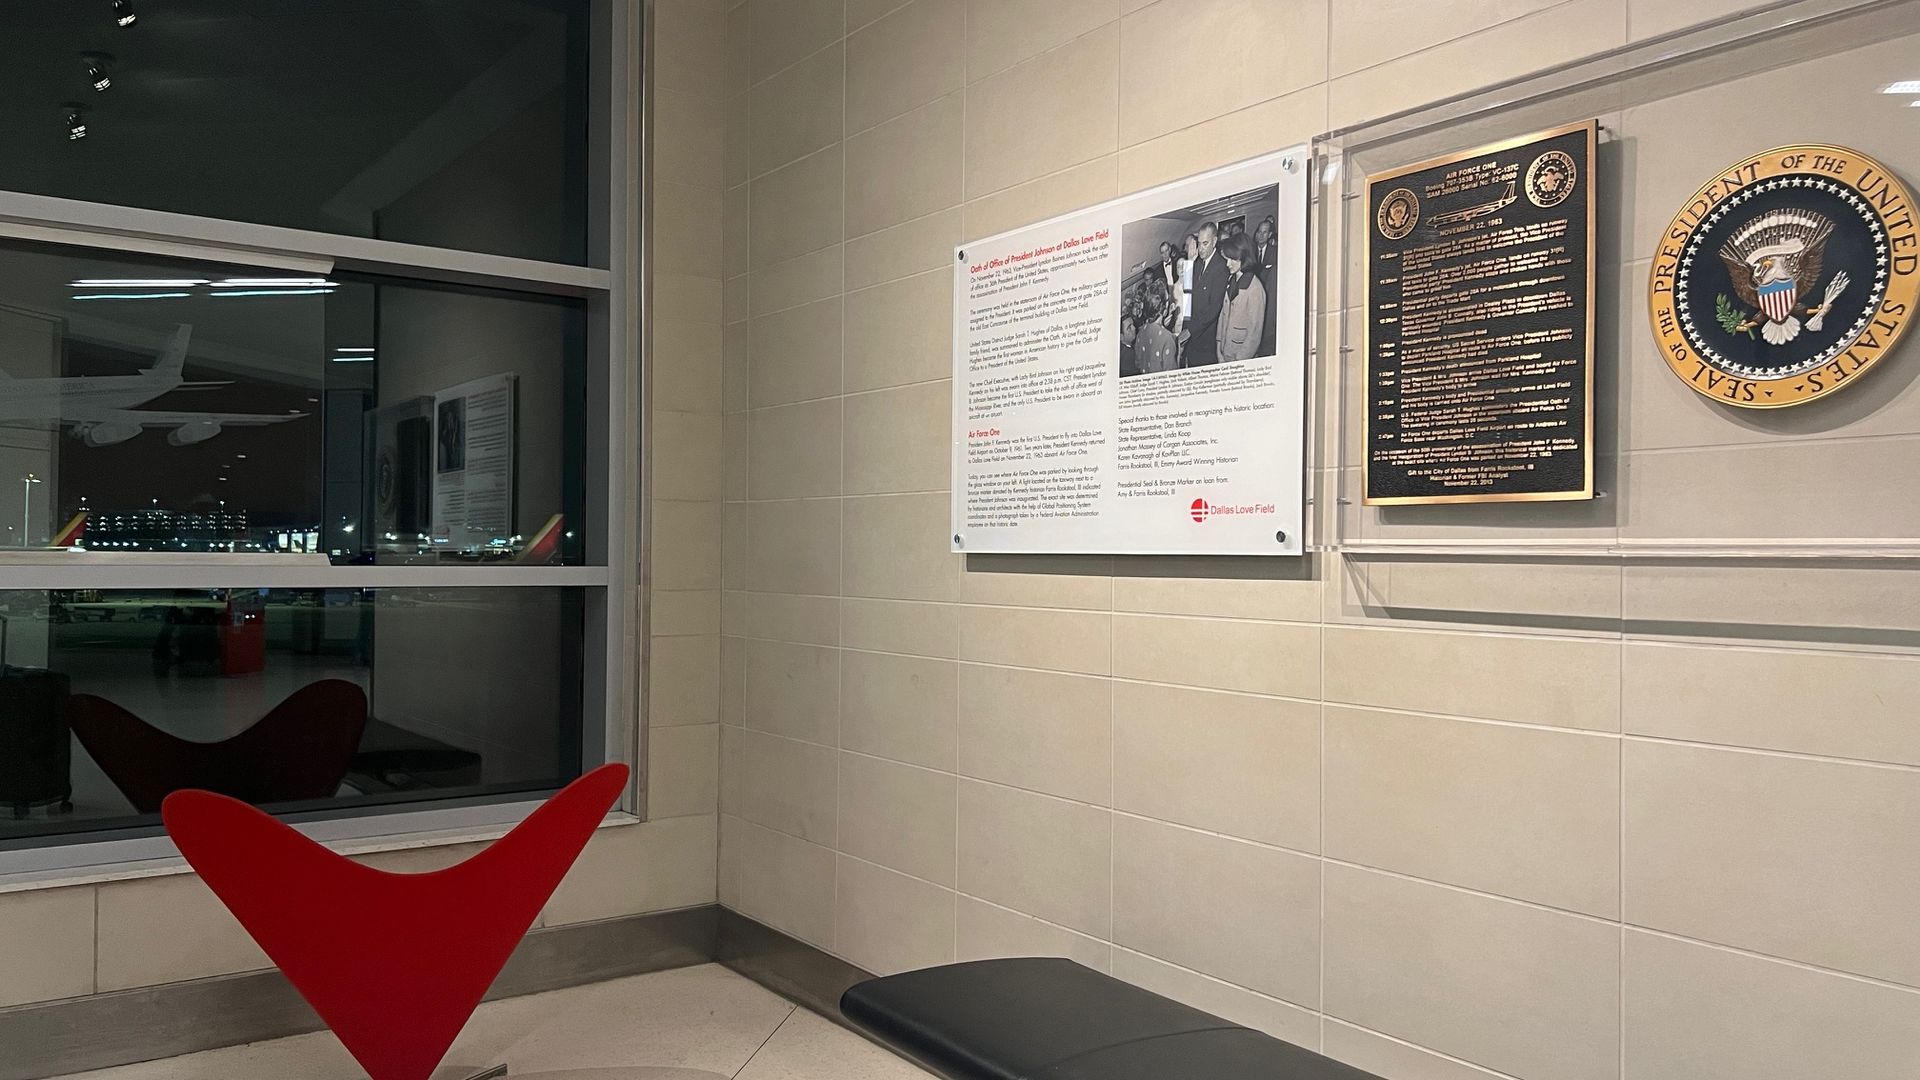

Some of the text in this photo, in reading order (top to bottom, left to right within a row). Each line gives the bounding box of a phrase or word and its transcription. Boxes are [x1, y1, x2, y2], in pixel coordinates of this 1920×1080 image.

[1446, 162, 1497, 180] AIR FORCE ONE
[1440, 224, 1475, 237] NOVEMBER
[970, 229, 1109, 274] Oath of Office of President Johnson at Dallas Love Field
[1654, 154, 1918, 401] SEAL OF THE PRESIDENT OF THE UNITED STATES
[1118, 416, 1135, 426] Special
[1234, 404, 1251, 413] historic
[1175, 420, 1192, 428] Branch
[990, 428, 1000, 436] One
[1178, 431, 1192, 439] Koop
[1194, 458, 1215, 466] Winning
[1118, 491, 1128, 499] Amy
[1210, 504, 1275, 515] Dallas Love Field
